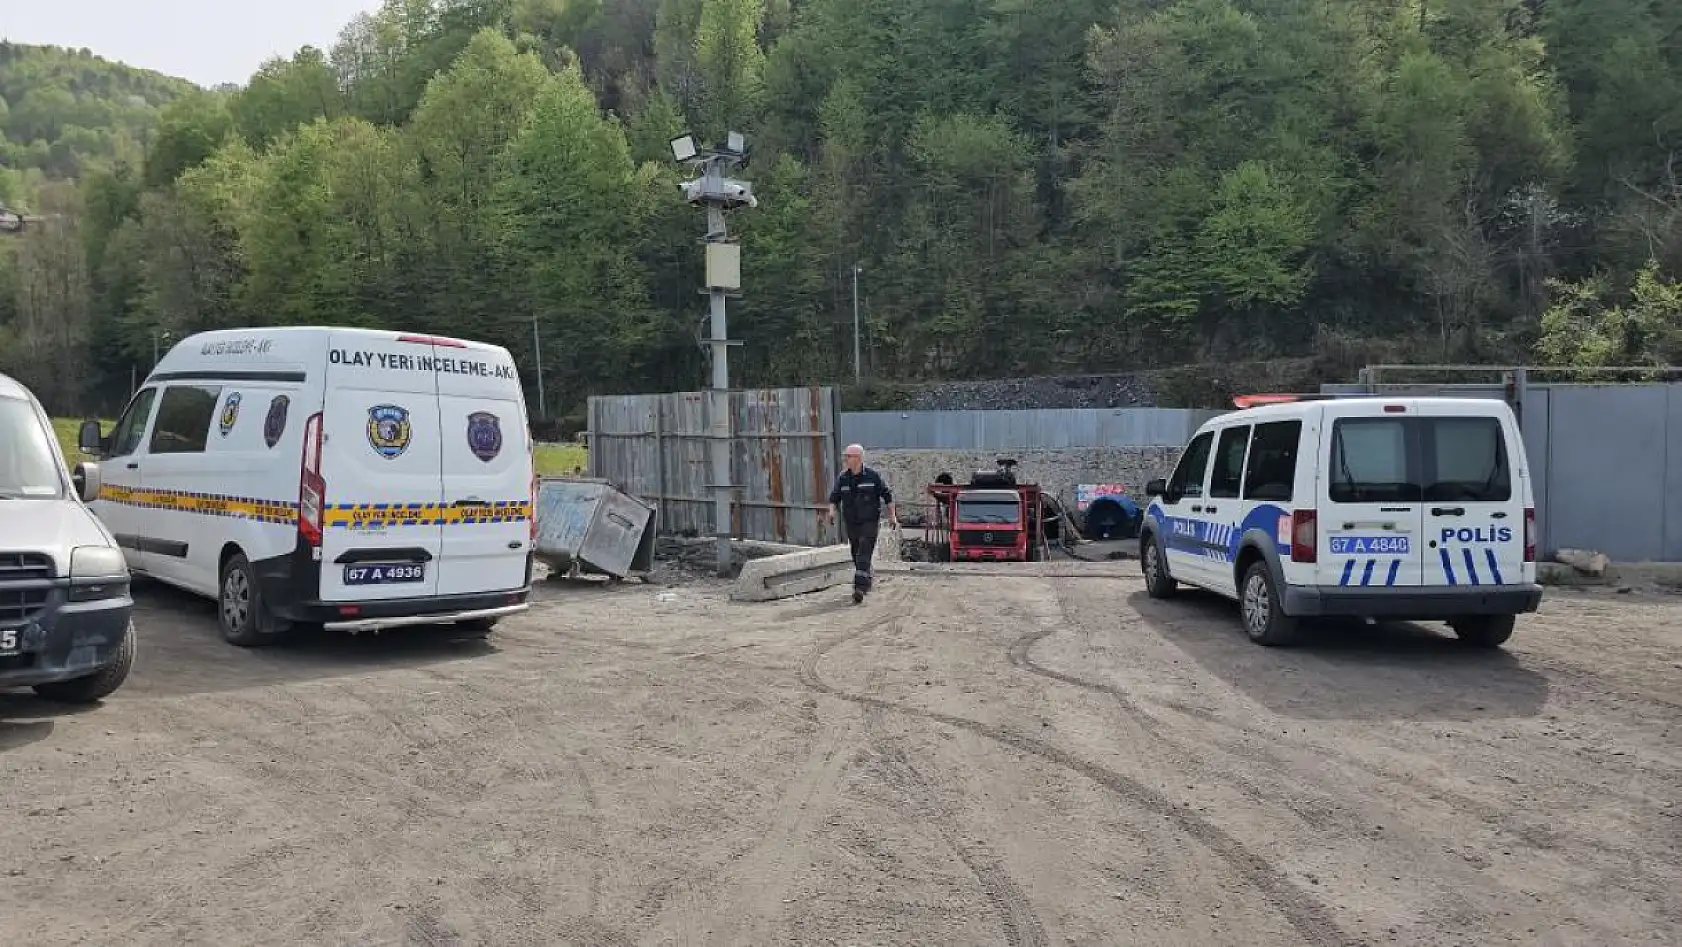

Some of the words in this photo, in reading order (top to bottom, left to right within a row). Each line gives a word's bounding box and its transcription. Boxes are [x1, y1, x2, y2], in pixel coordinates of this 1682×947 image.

[329, 349, 374, 367] OLAY
[1441, 524, 1512, 542] POLİS
[1354, 538, 1367, 552] A
[371, 567, 382, 579] A
[386, 566, 422, 579] 4936
